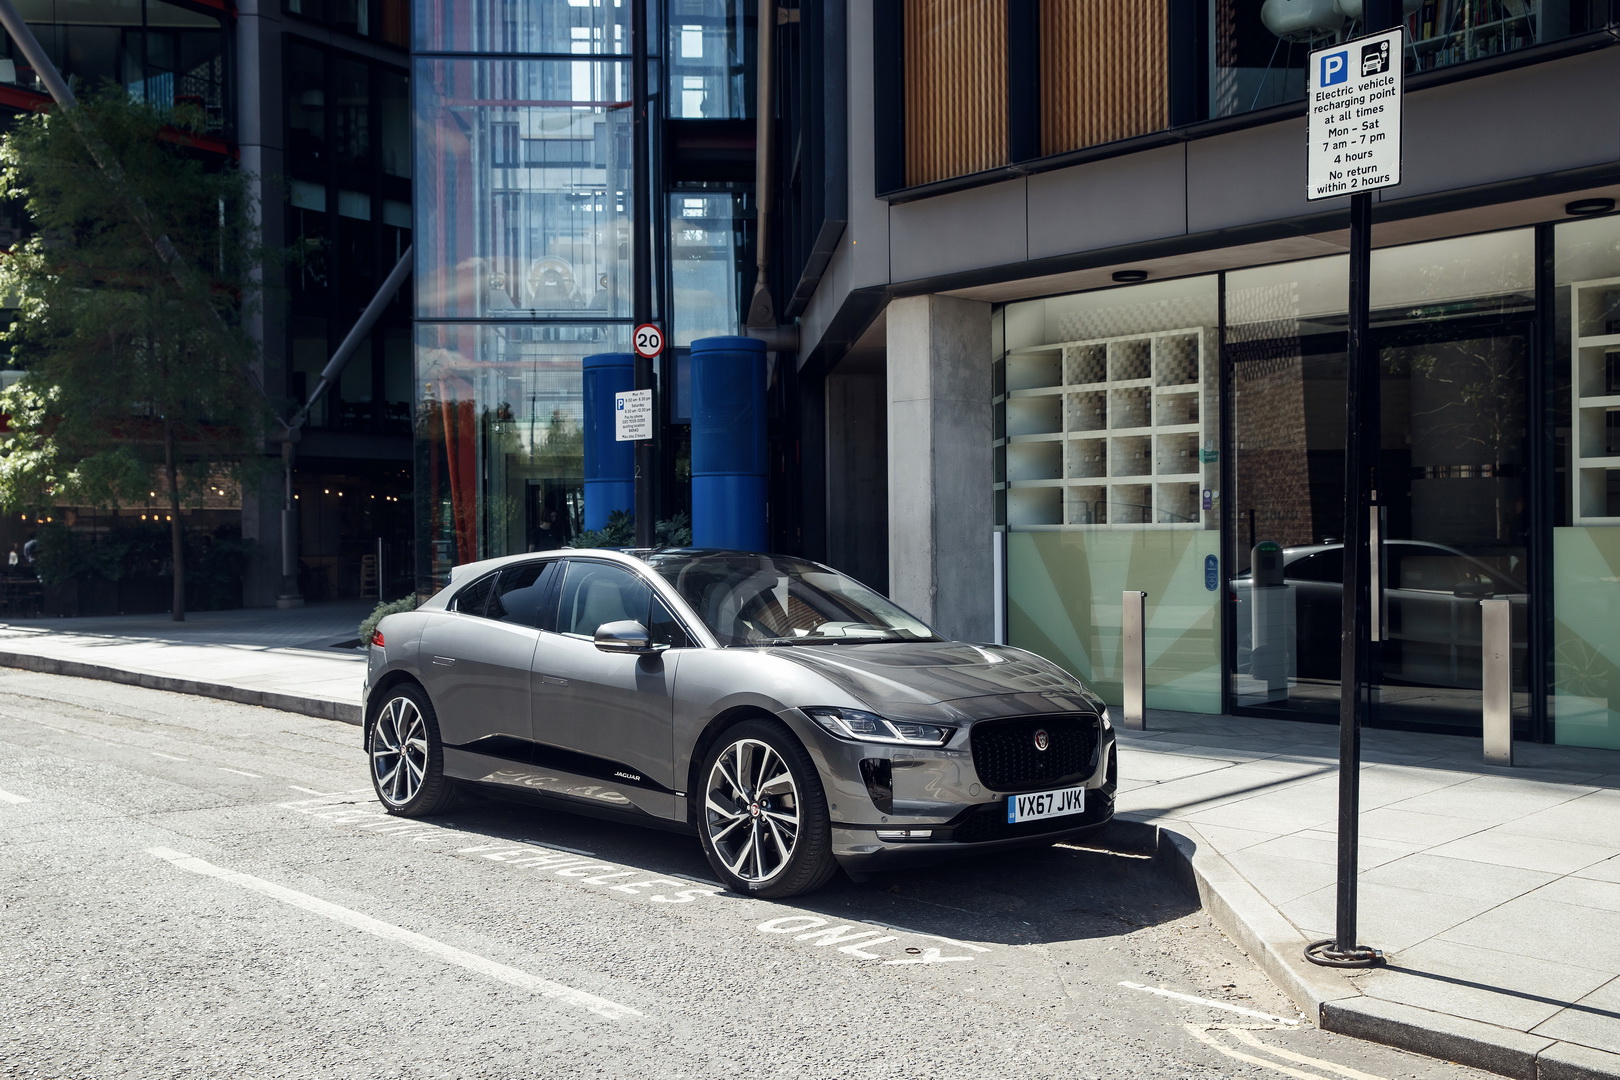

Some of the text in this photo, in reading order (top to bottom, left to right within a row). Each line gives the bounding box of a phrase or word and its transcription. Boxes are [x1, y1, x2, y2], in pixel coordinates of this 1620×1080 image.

[1325, 56, 1343, 84] P
[1316, 76, 1394, 102] Electric vehicle
[1314, 86, 1396, 114] recharging point
[1324, 104, 1384, 124] at all times
[1329, 126, 1348, 138] Mon
[1362, 119, 1380, 131] Sat
[1323, 142, 1329, 152] 7
[1333, 140, 1347, 149] am
[1360, 134, 1366, 145] 7
[1370, 132, 1386, 145] pm
[1334, 149, 1373, 164] 4 hours
[1330, 164, 1377, 180] No return
[1317, 173, 1390, 194] within 2 hours
[638, 334, 659, 348] 20
[614, 771, 640, 781] JAGUAR
[1018, 790, 1081, 817] VX67 JVK
[456, 843, 724, 904] VEHICLES
[756, 916, 974, 964] ONLY
